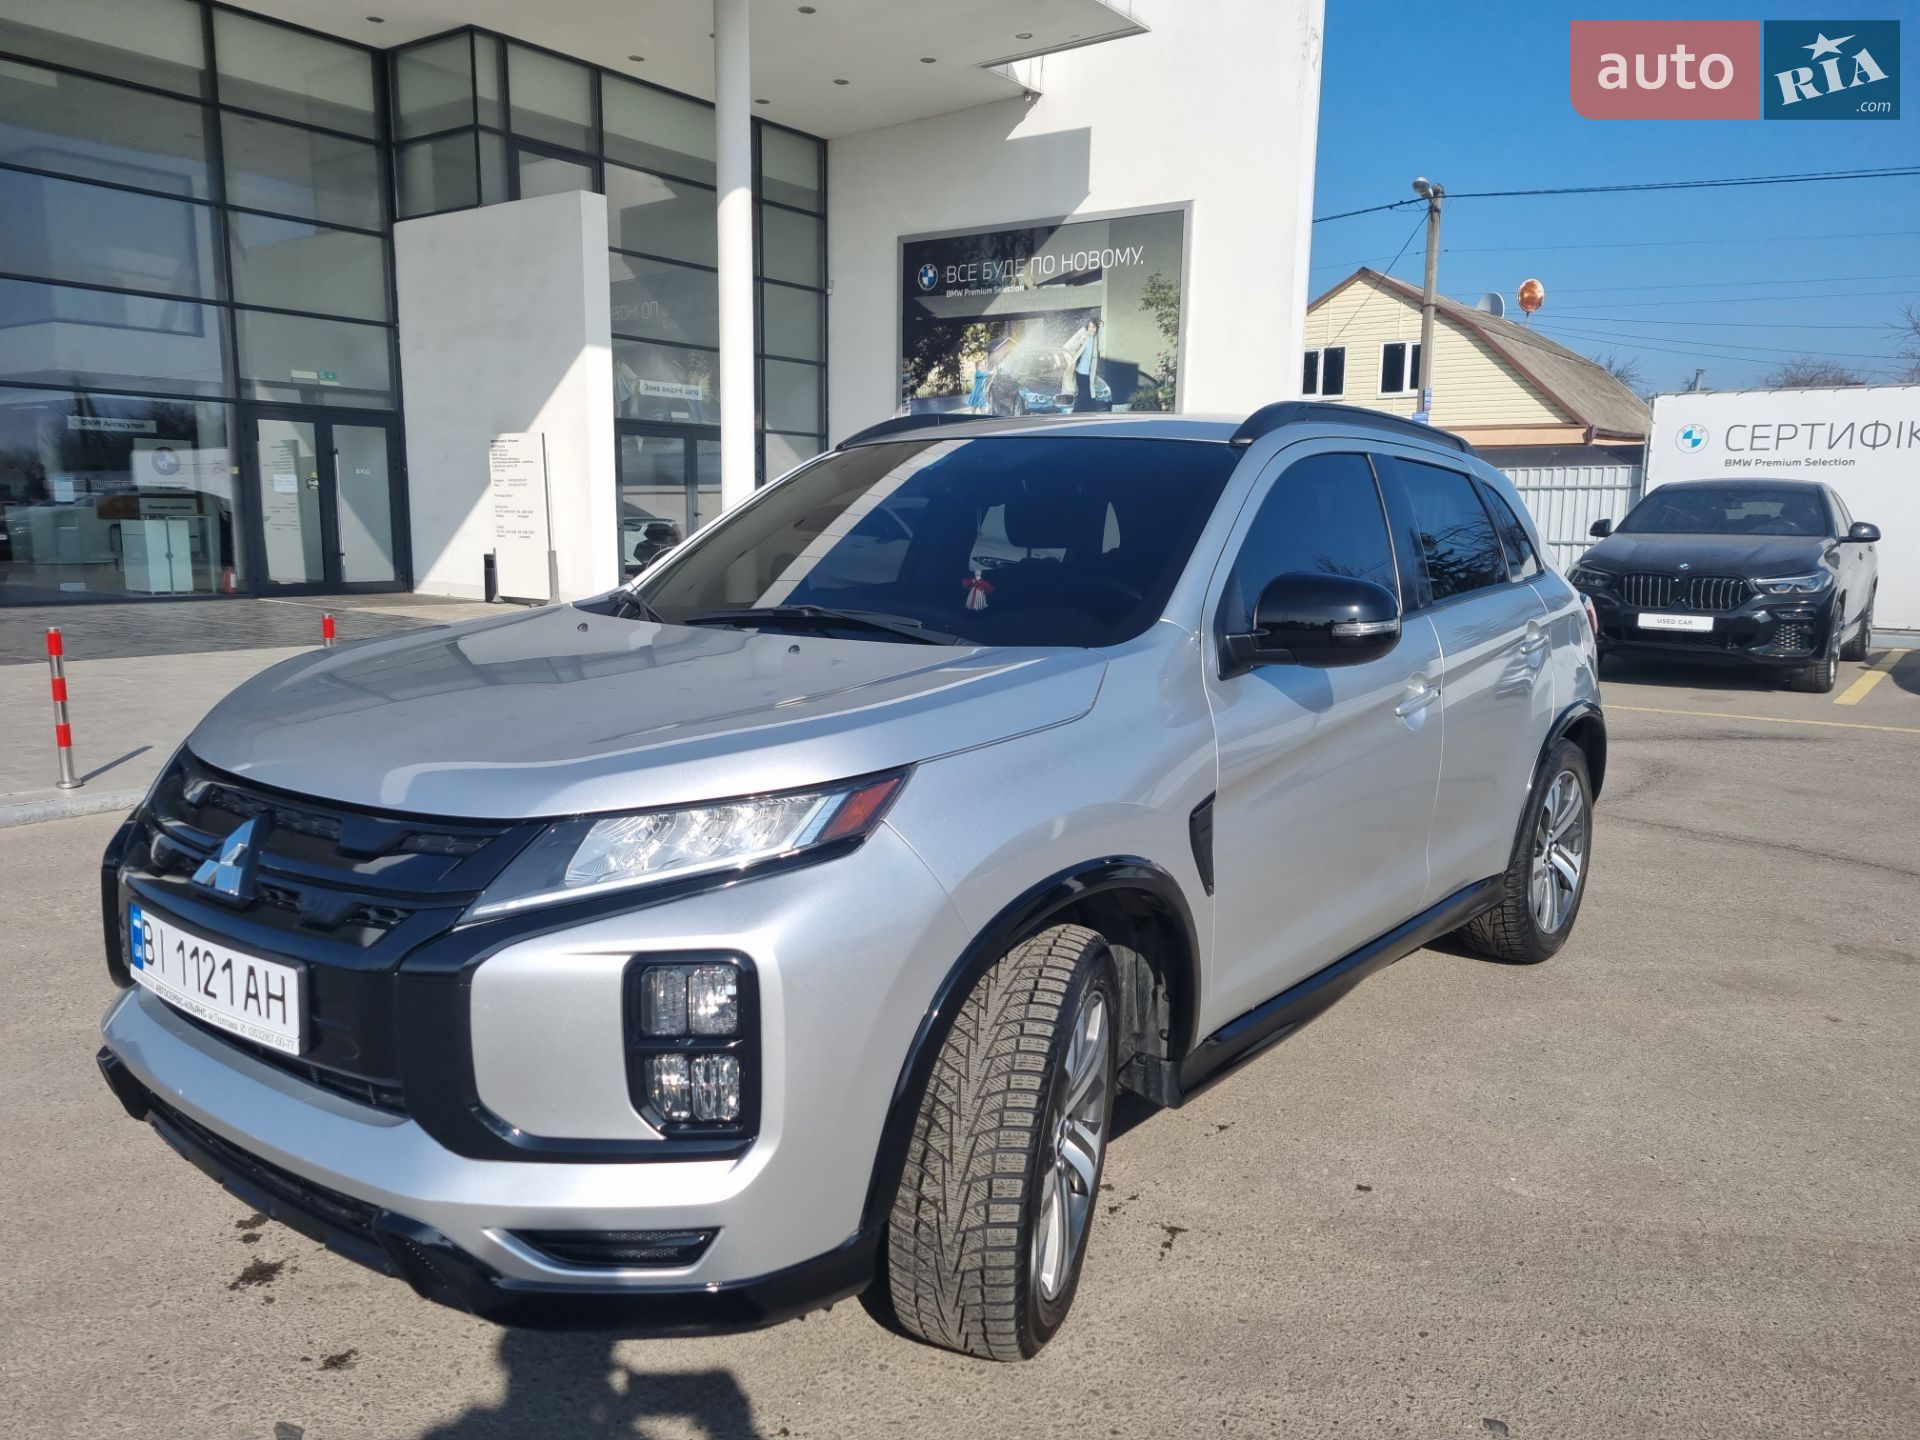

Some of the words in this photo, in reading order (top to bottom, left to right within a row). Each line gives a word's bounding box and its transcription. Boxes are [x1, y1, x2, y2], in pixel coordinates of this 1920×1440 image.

[946, 264, 977, 284] ВСЕ
[982, 259, 1025, 280] БУДЕ
[1030, 255, 1055, 276] ПО
[1061, 246, 1144, 272] НОВОМУ.
[946, 289, 963, 298] BMW
[964, 287, 992, 296] Premium
[993, 285, 1025, 294] Selection
[1725, 420, 1920, 451] СЕРТИФІК
[1724, 459, 1752, 467] BMW
[1755, 458, 1801, 467] Premium
[1805, 457, 1855, 467] Selection
[176, 939, 234, 1006] 1121
[244, 965, 287, 1024] AH
